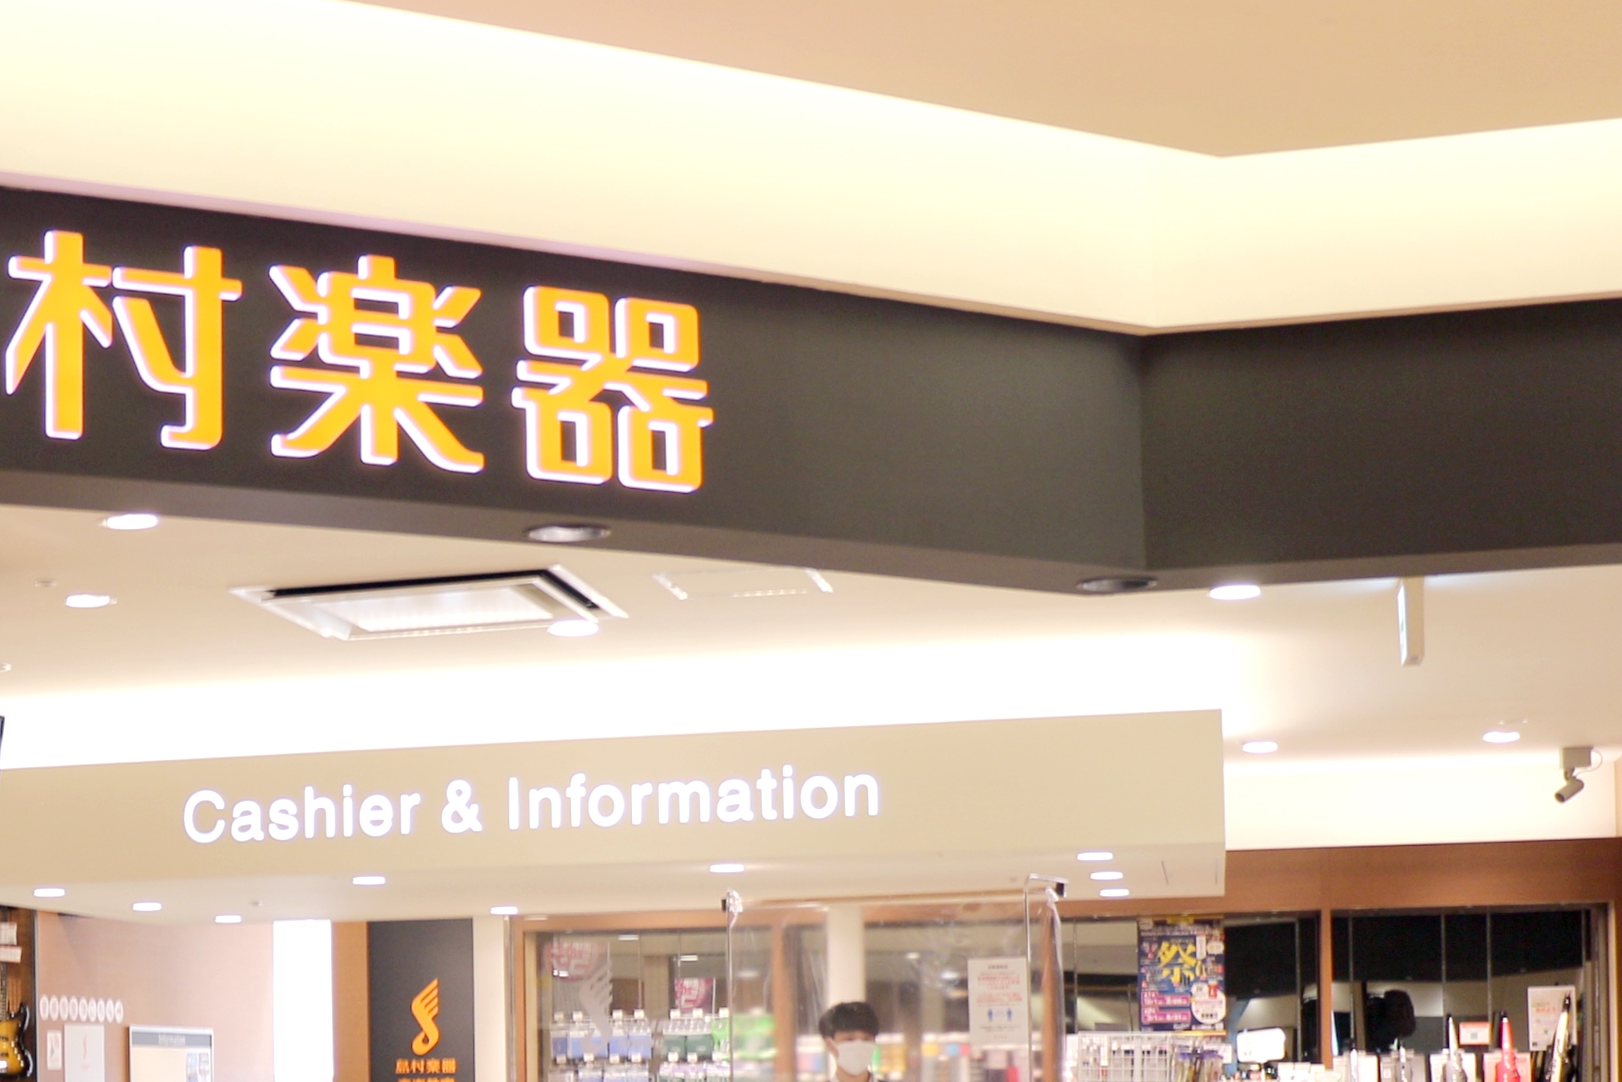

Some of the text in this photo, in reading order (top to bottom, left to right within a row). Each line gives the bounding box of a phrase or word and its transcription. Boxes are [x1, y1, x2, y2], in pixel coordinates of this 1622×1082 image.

[182, 761, 884, 845] Cashier & Information
[395, 1058, 457, 1074] 島村楽器
